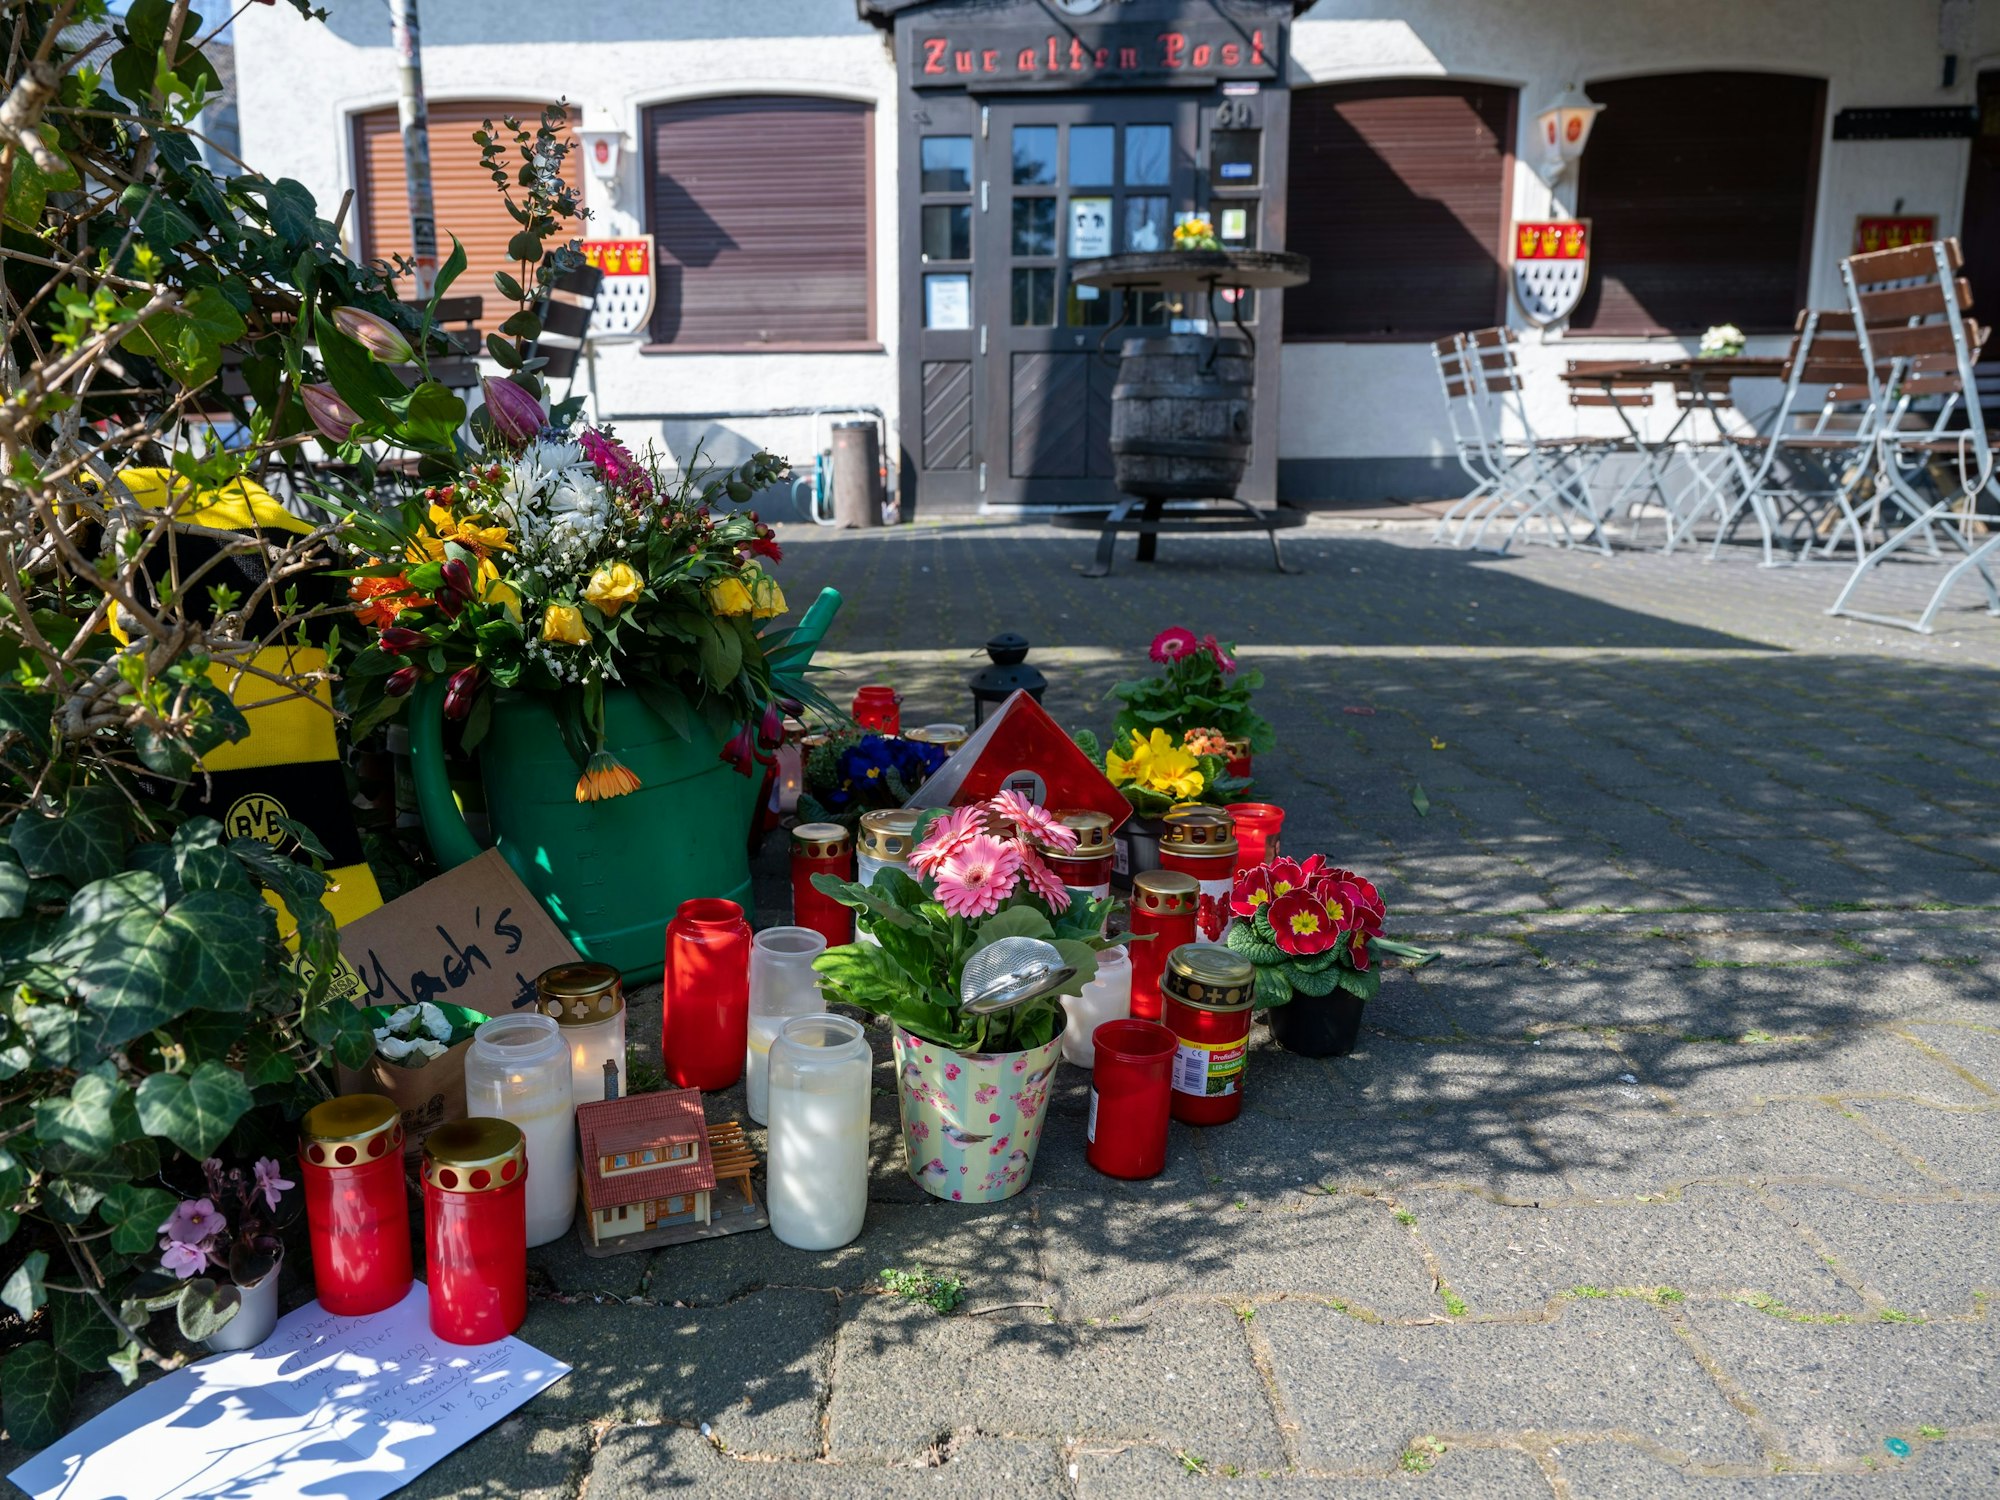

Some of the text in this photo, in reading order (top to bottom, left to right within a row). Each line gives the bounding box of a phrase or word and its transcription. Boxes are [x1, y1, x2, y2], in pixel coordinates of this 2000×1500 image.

[923, 29, 1266, 75] Zur alten Post
[1215, 102, 1253, 126] 60
[236, 800, 281, 837] BVB
[359, 906, 523, 1007] Mach's
